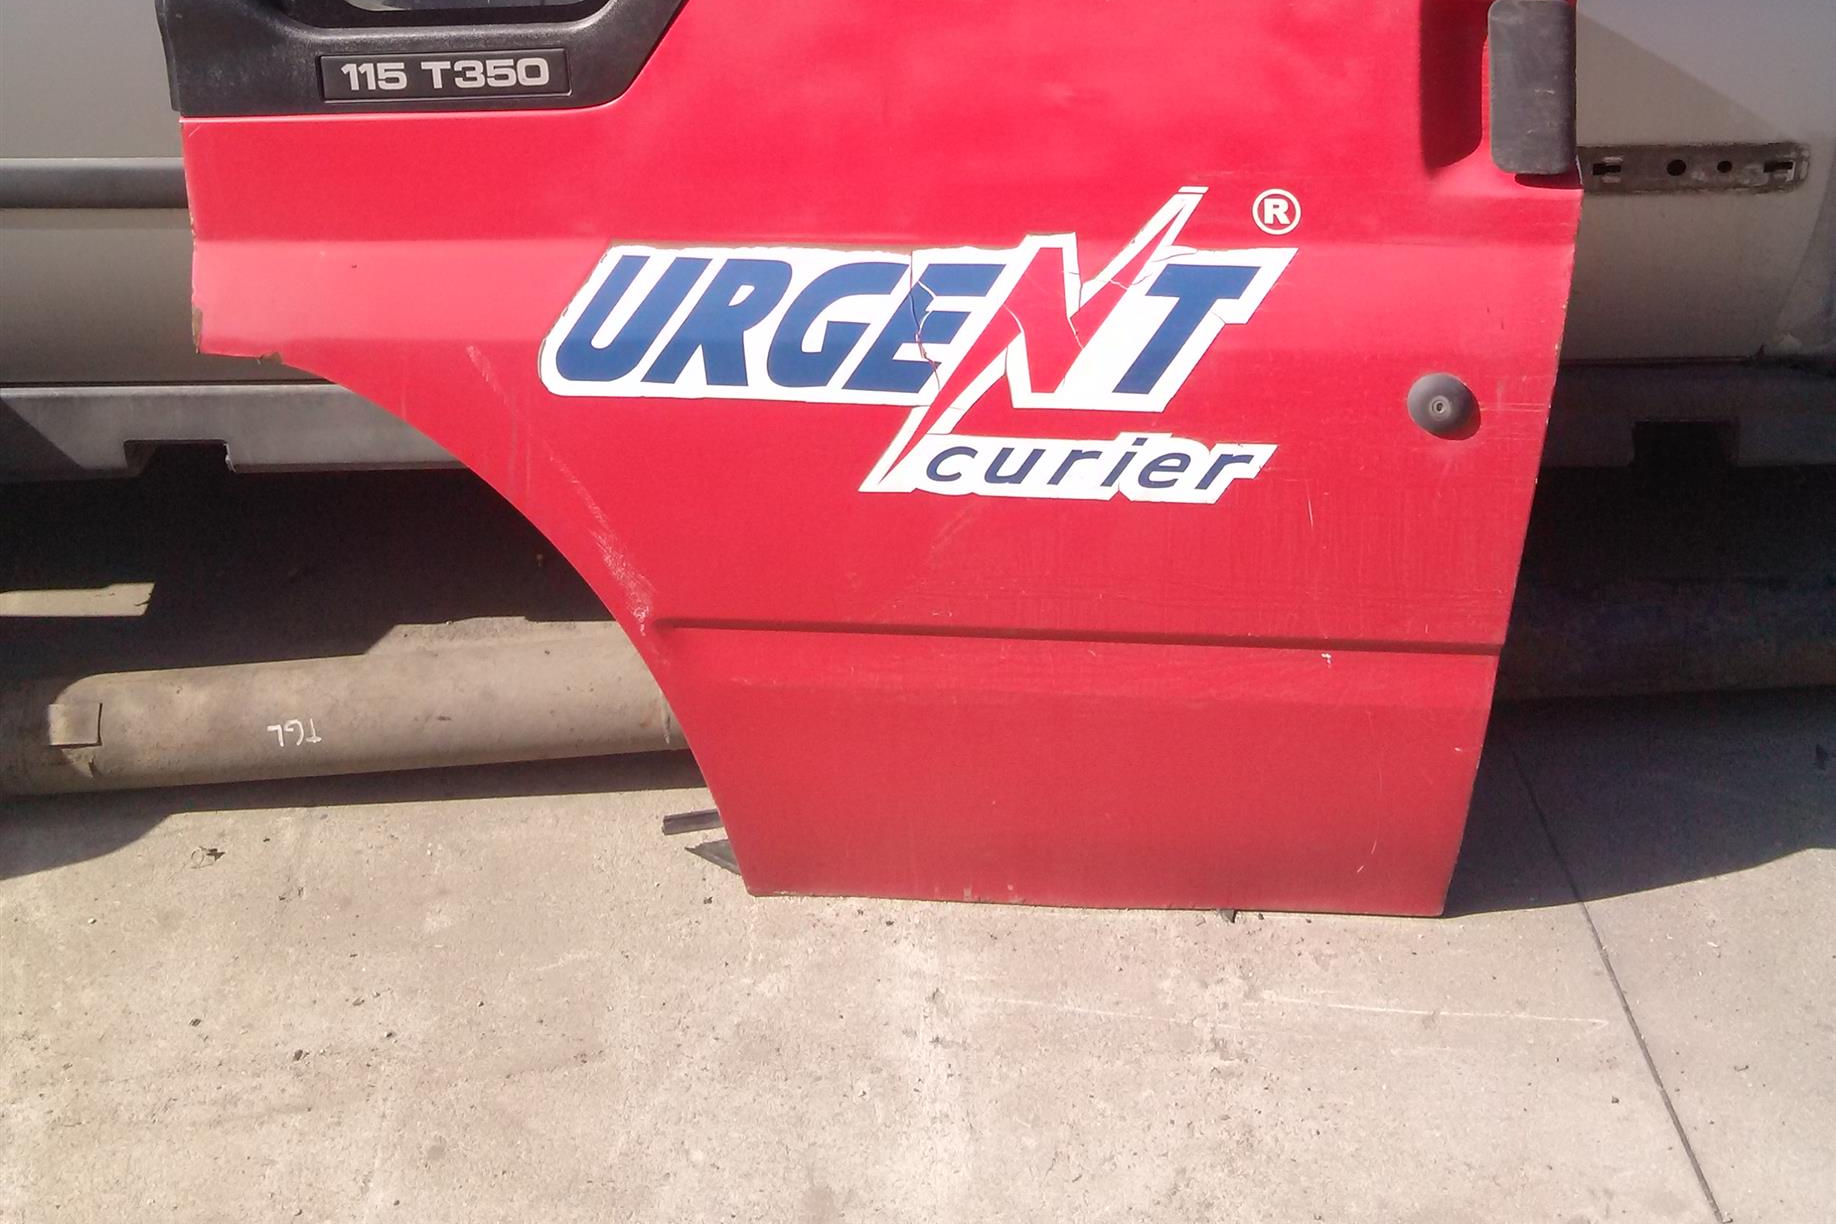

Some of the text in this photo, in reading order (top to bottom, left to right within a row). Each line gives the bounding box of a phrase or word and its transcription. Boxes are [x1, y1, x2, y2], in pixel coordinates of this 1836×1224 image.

[340, 57, 550, 92] 115 T350
[548, 221, 1275, 426] URGENT
[924, 436, 1256, 492] curier
[266, 718, 322, 748] TGL
